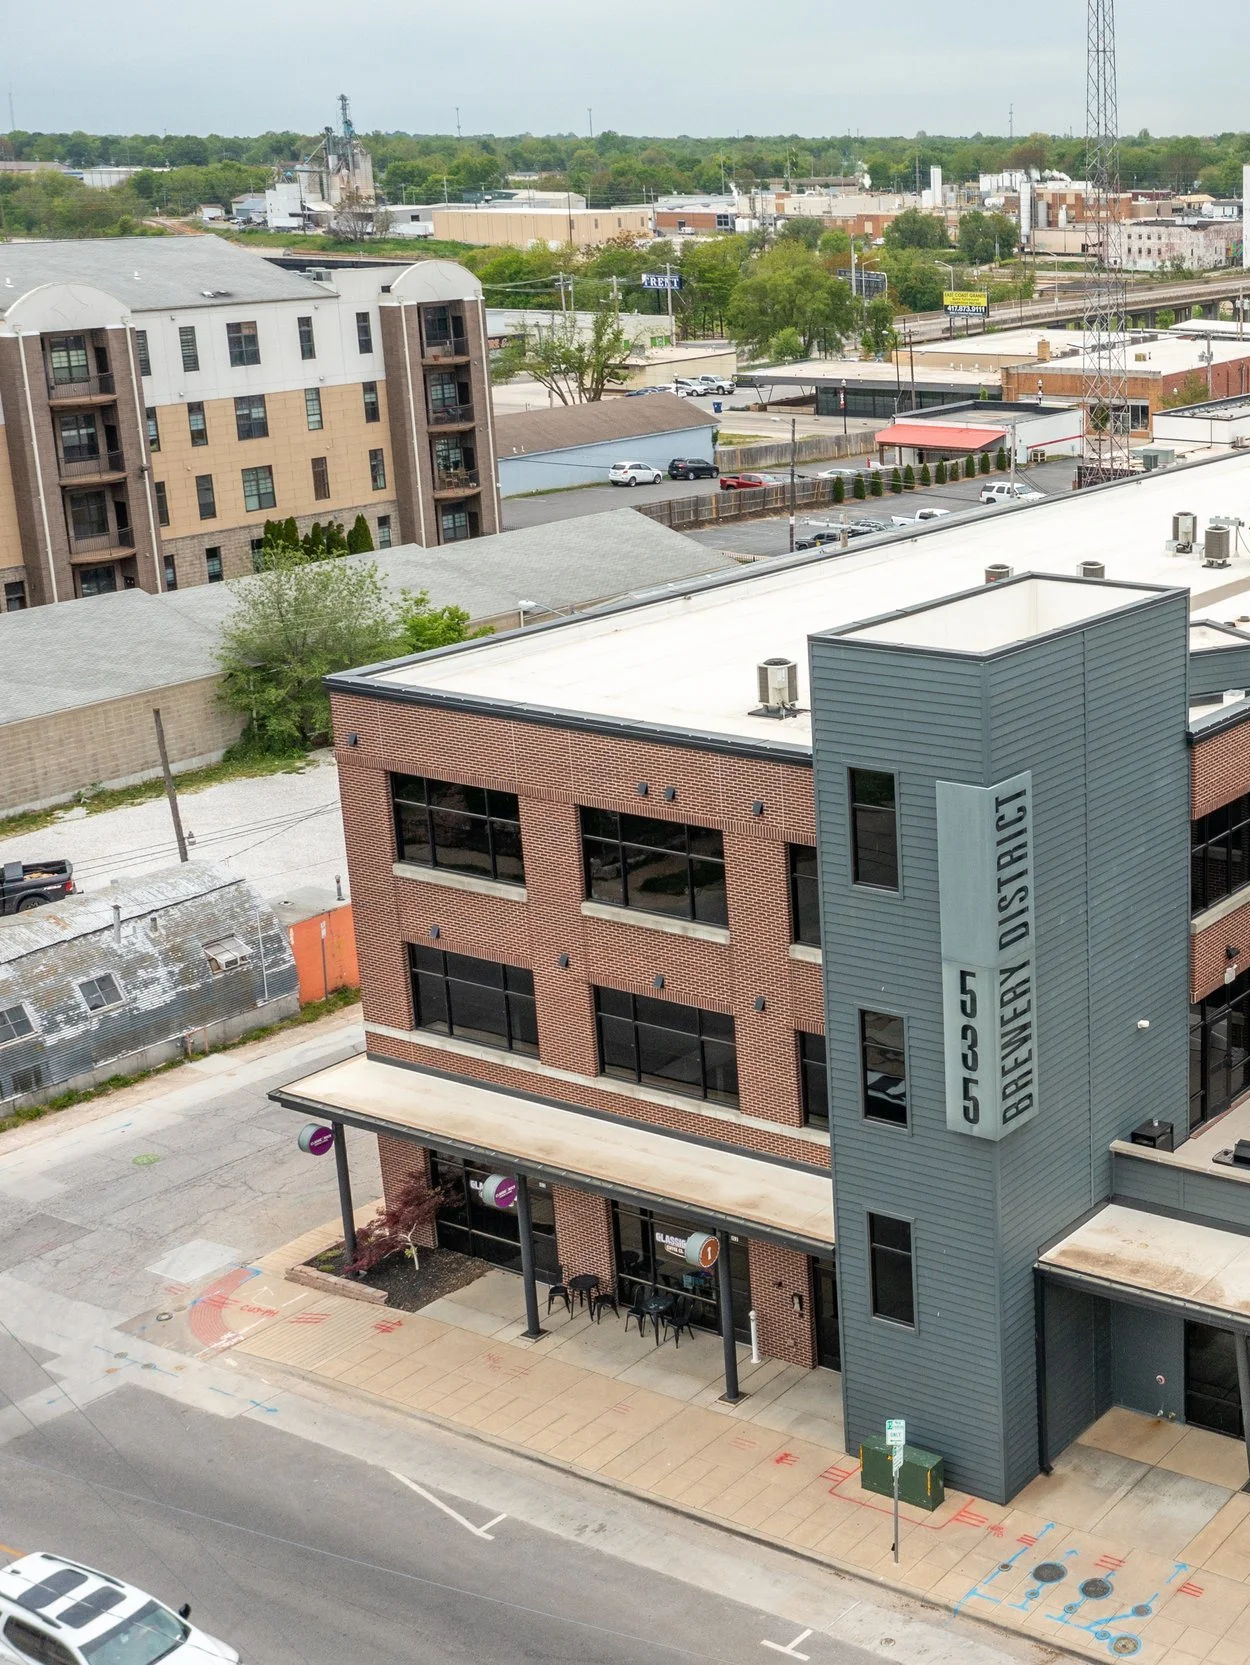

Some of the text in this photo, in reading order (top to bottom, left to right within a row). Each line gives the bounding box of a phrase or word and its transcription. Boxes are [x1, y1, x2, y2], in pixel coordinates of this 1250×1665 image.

[959, 969, 980, 1125] 535
[995, 788, 1034, 1126] BREWERY DISTRICT
